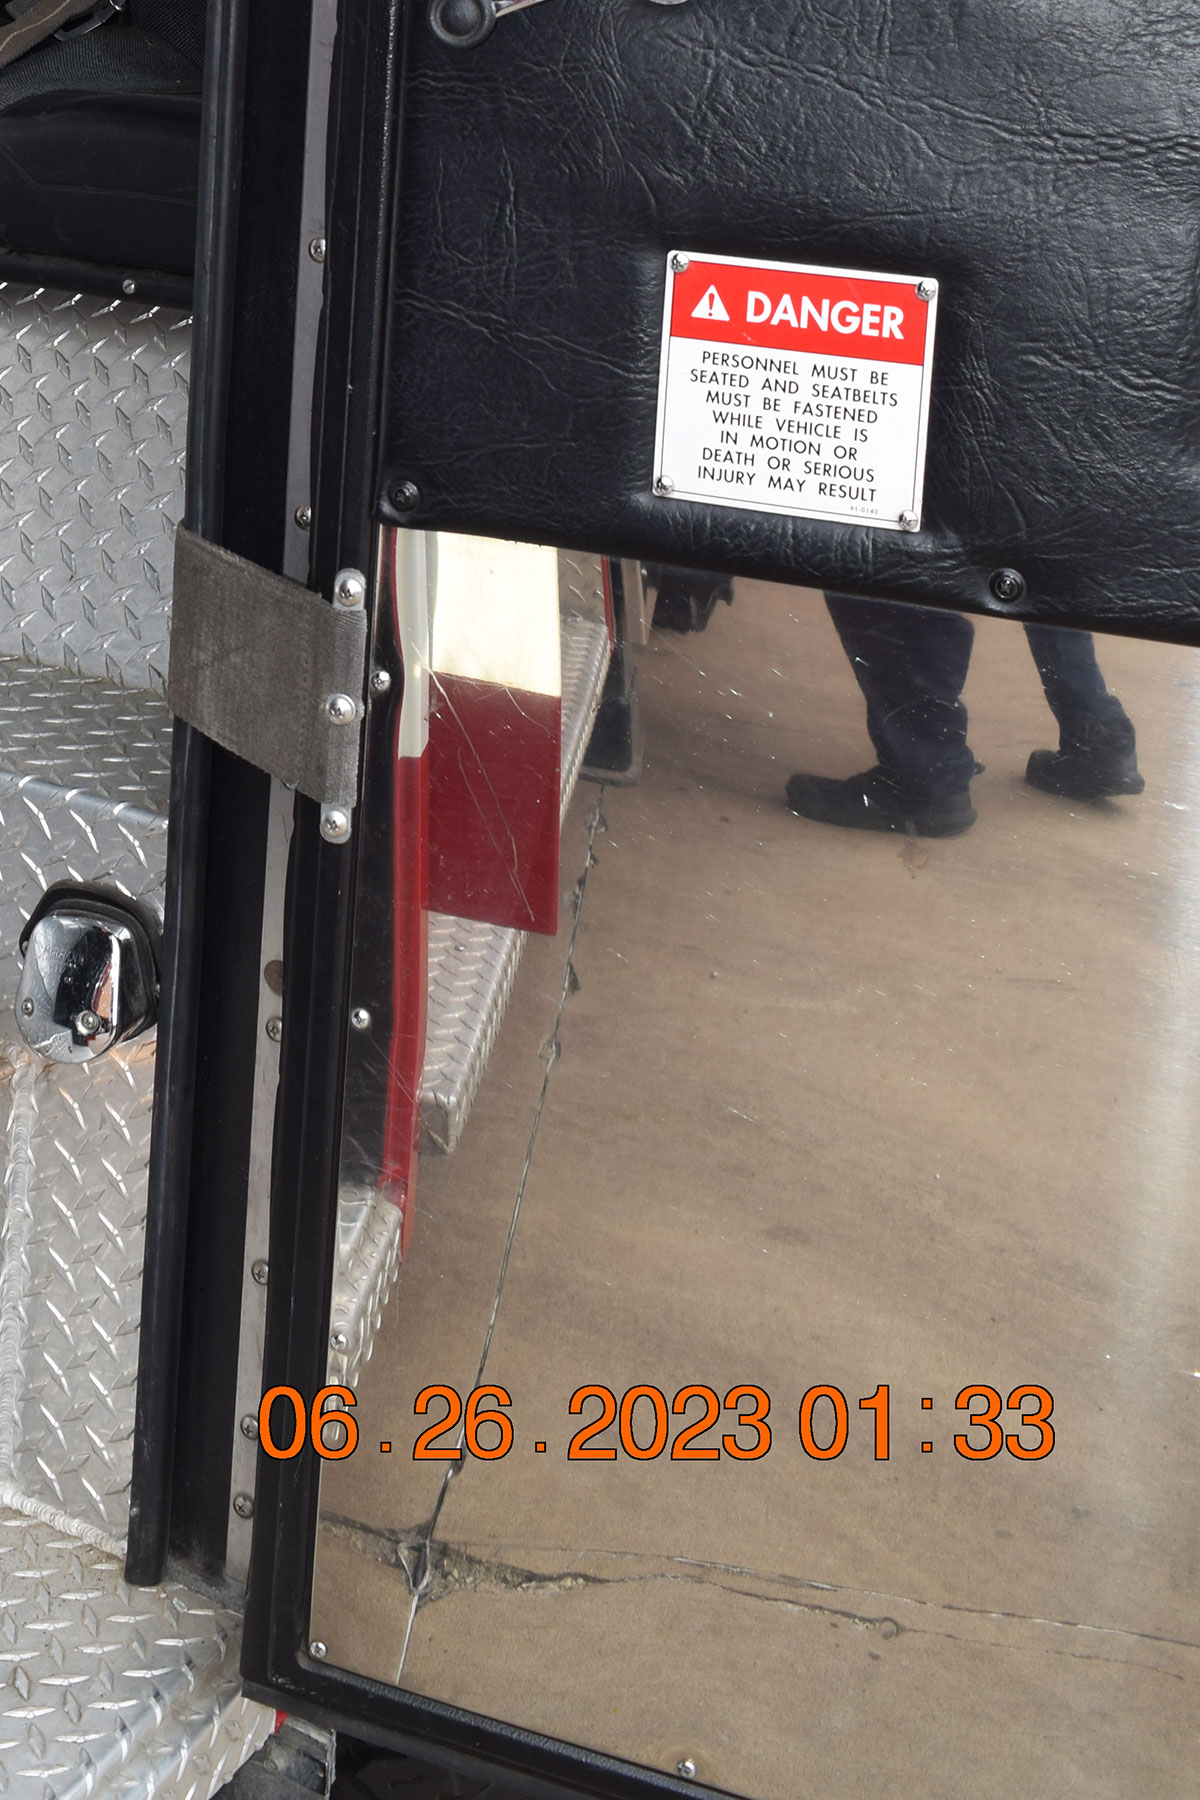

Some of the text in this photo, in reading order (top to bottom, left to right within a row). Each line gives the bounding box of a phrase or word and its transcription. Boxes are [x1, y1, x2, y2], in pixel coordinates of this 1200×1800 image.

[745, 290, 905, 340] DANGER
[702, 350, 889, 386] PERSONNEL MUST BE
[690, 368, 898, 407] SEATED AND SEATBELTS
[705, 390, 878, 424] MUST BE FASTENED
[712, 410, 868, 443] WHILE VEHICLE IS
[720, 430, 858, 461] IN MOTION OR
[702, 447, 874, 483] DEATH OR SERIOUS
[698, 465, 877, 502] INJURY MAY RESULT
[849, 505, 879, 515] 91-0140
